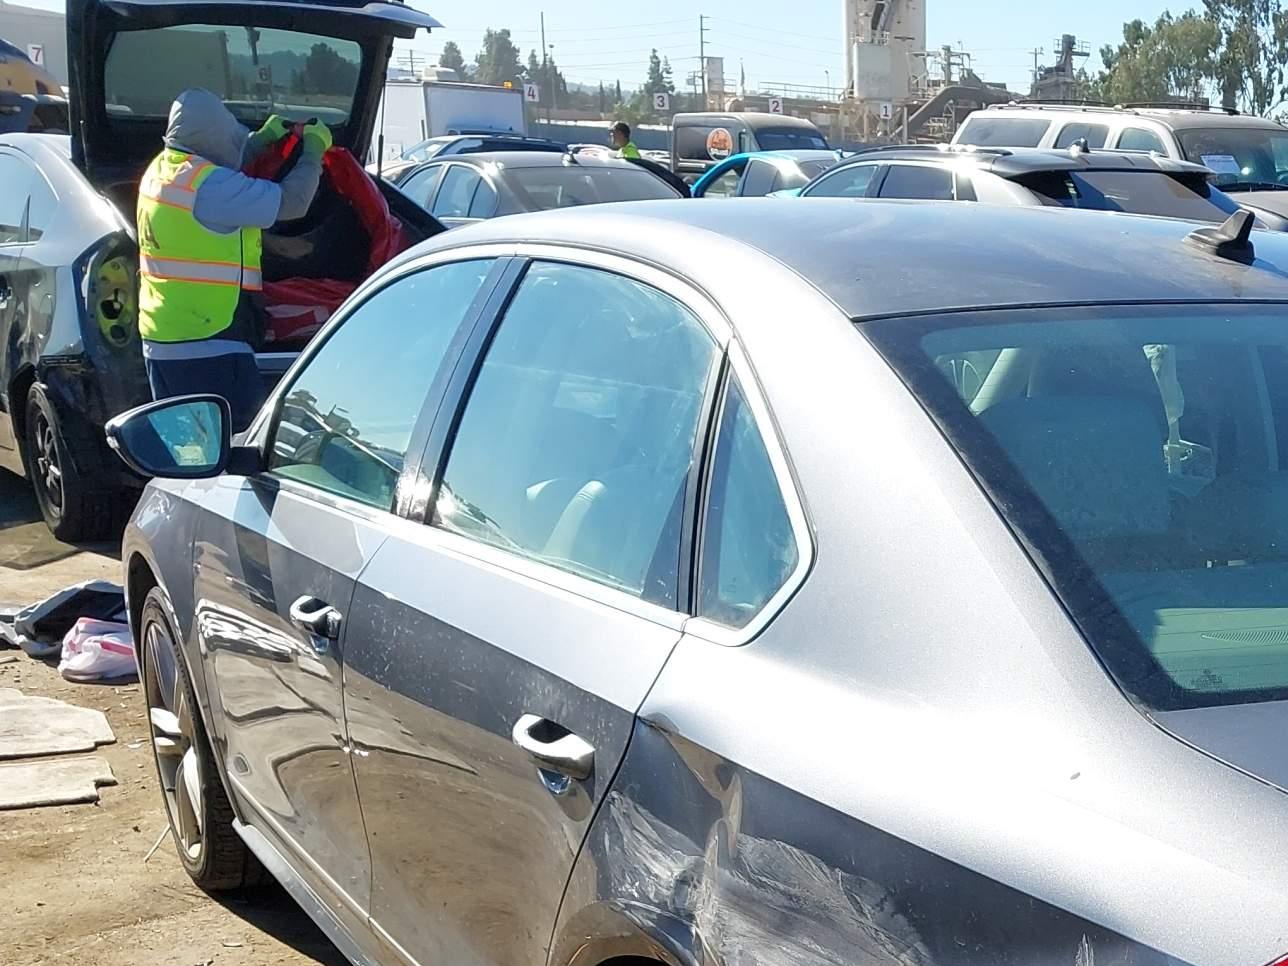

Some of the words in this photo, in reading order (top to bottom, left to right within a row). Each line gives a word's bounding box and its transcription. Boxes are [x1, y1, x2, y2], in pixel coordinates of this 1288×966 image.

[31, 47, 42, 62] 7
[527, 86, 536, 100] 4
[656, 95, 665, 108] 3
[771, 100, 780, 112] 2
[883, 105, 889, 117] 1
